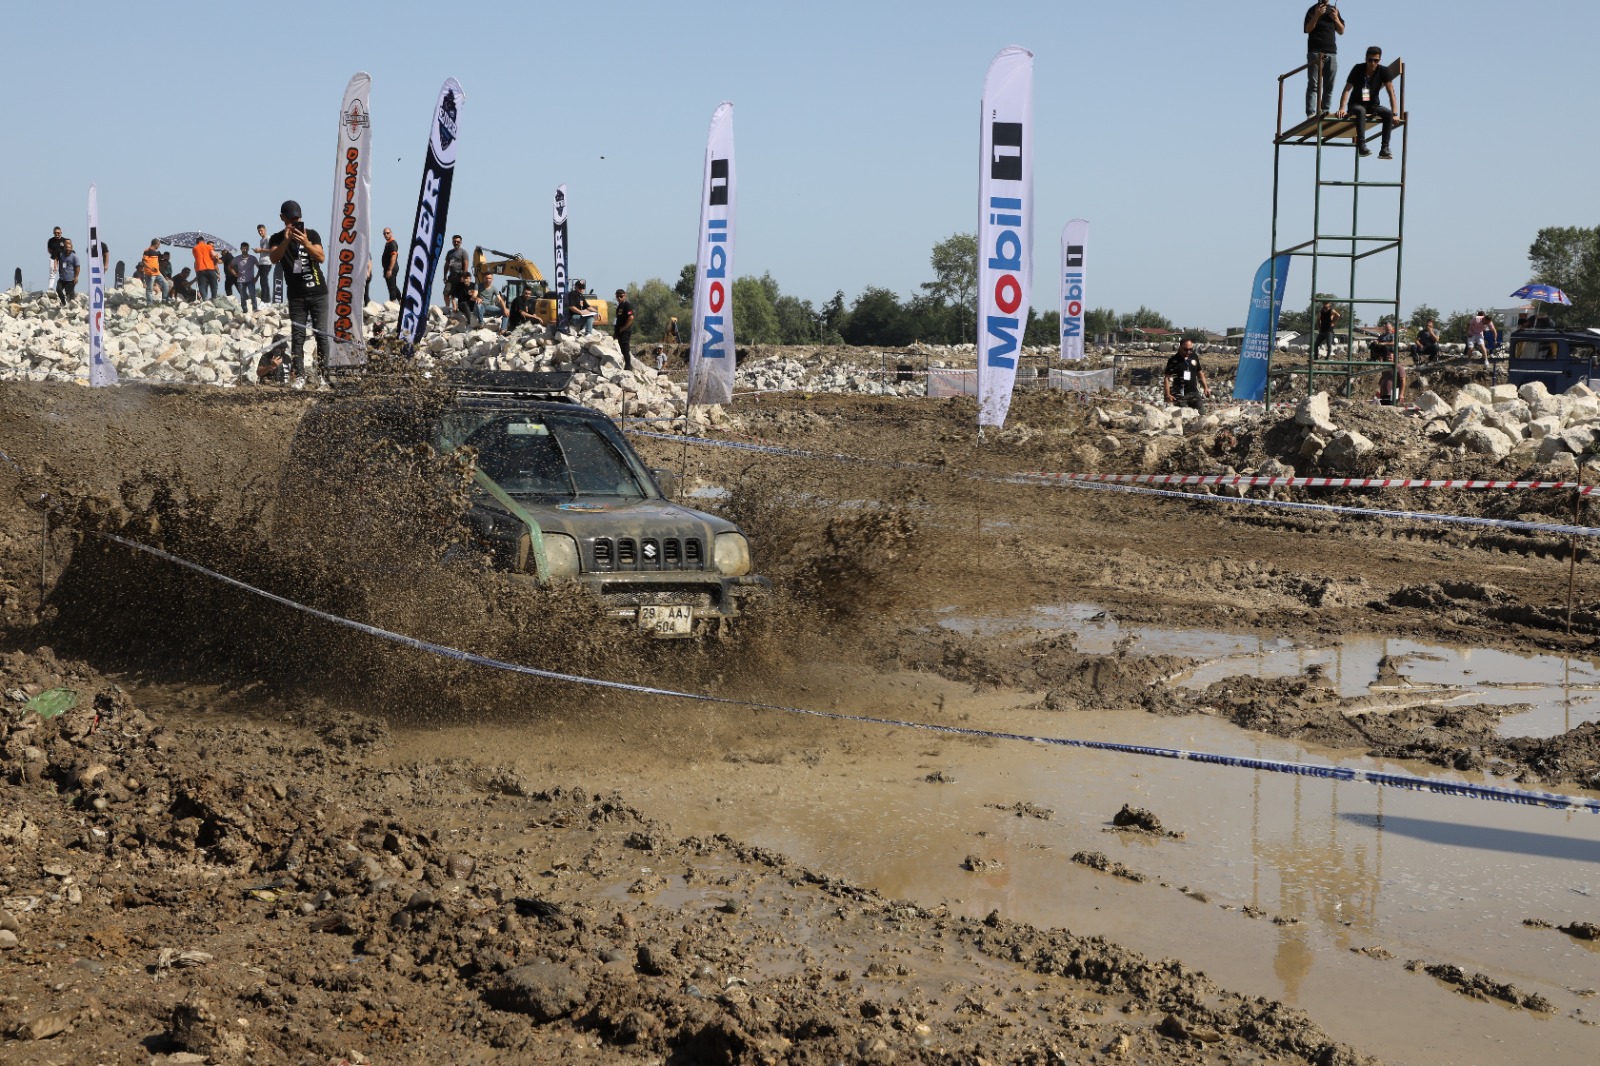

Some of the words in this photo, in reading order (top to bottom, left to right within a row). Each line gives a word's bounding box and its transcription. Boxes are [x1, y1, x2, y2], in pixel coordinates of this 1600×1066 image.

[993, 144, 1021, 163] 1
[711, 177, 727, 192] 1
[401, 168, 442, 341] EJDER
[1067, 253, 1082, 262] 1
[333, 248, 354, 343] OFFROAD
[701, 219, 728, 359] Mobil
[987, 196, 1023, 370] Mobil
[1064, 272, 1083, 337] Mobil
[1243, 350, 1269, 361] ORDU
[642, 607, 656, 619] 29
